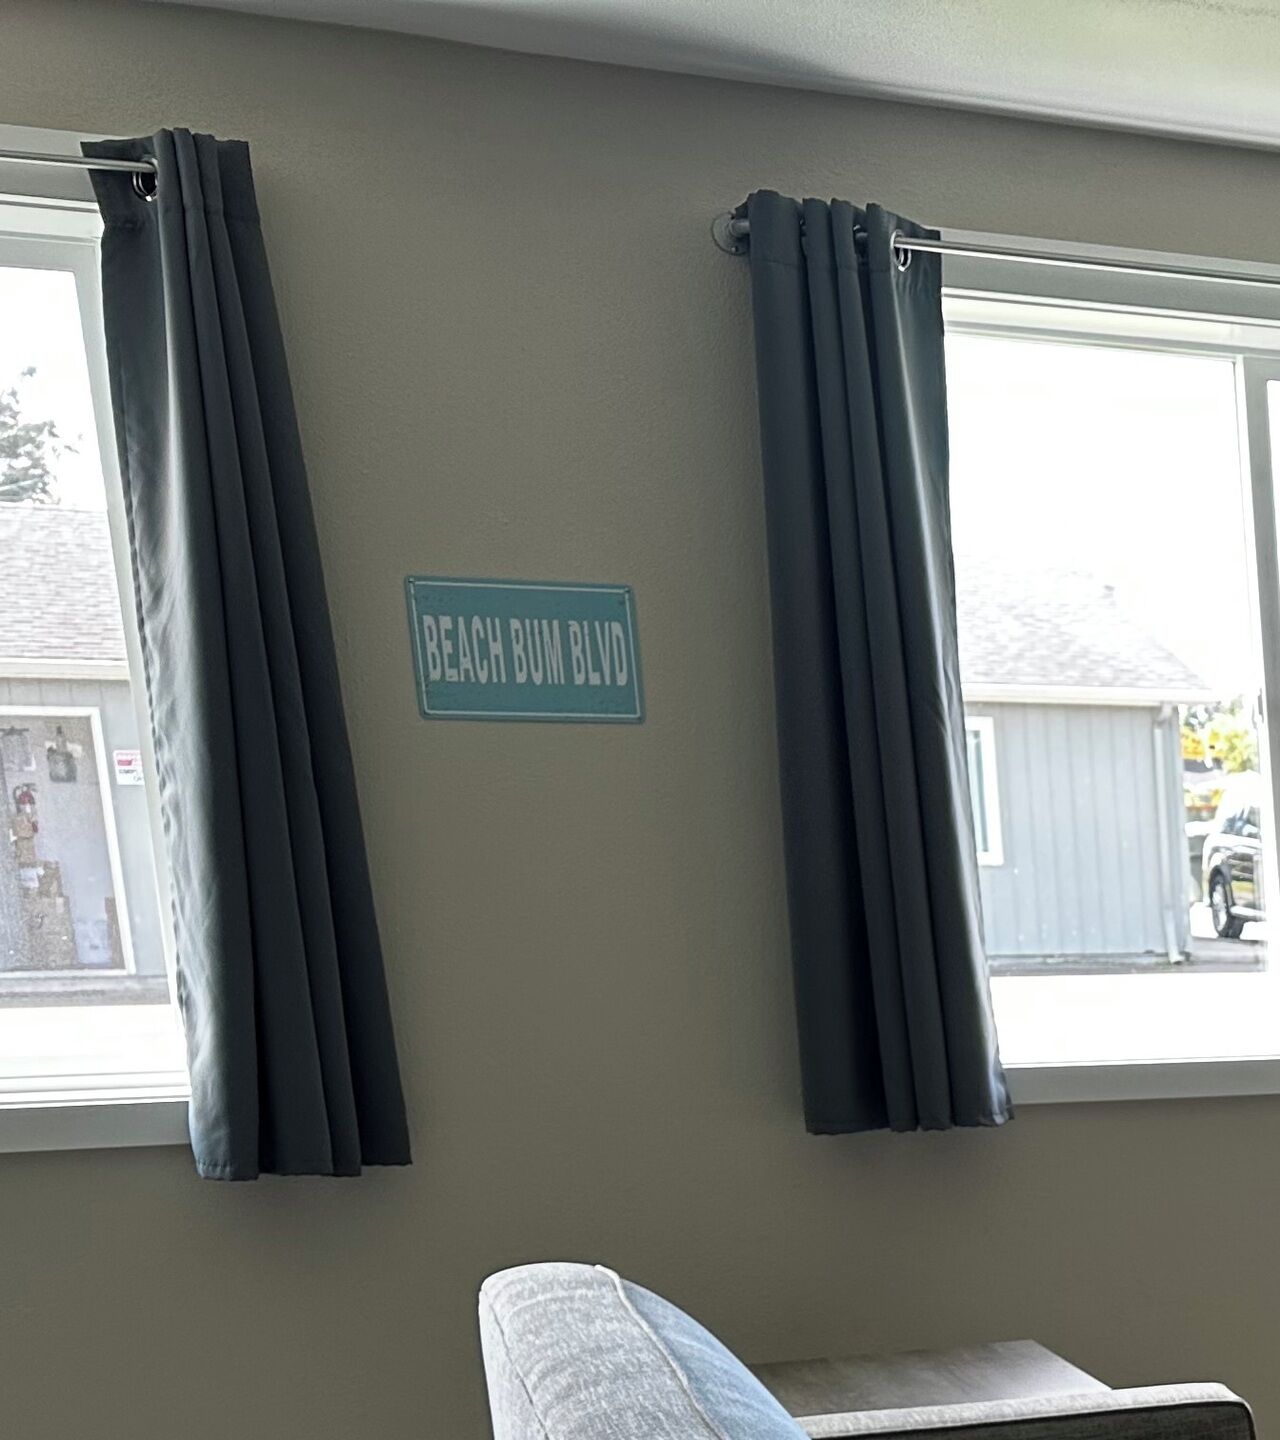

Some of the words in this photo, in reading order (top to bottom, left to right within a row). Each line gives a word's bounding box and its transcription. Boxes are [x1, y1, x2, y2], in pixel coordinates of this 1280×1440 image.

[422, 614, 507, 684] BEACH
[509, 617, 565, 686] BUM
[567, 620, 629, 686] BLVD
